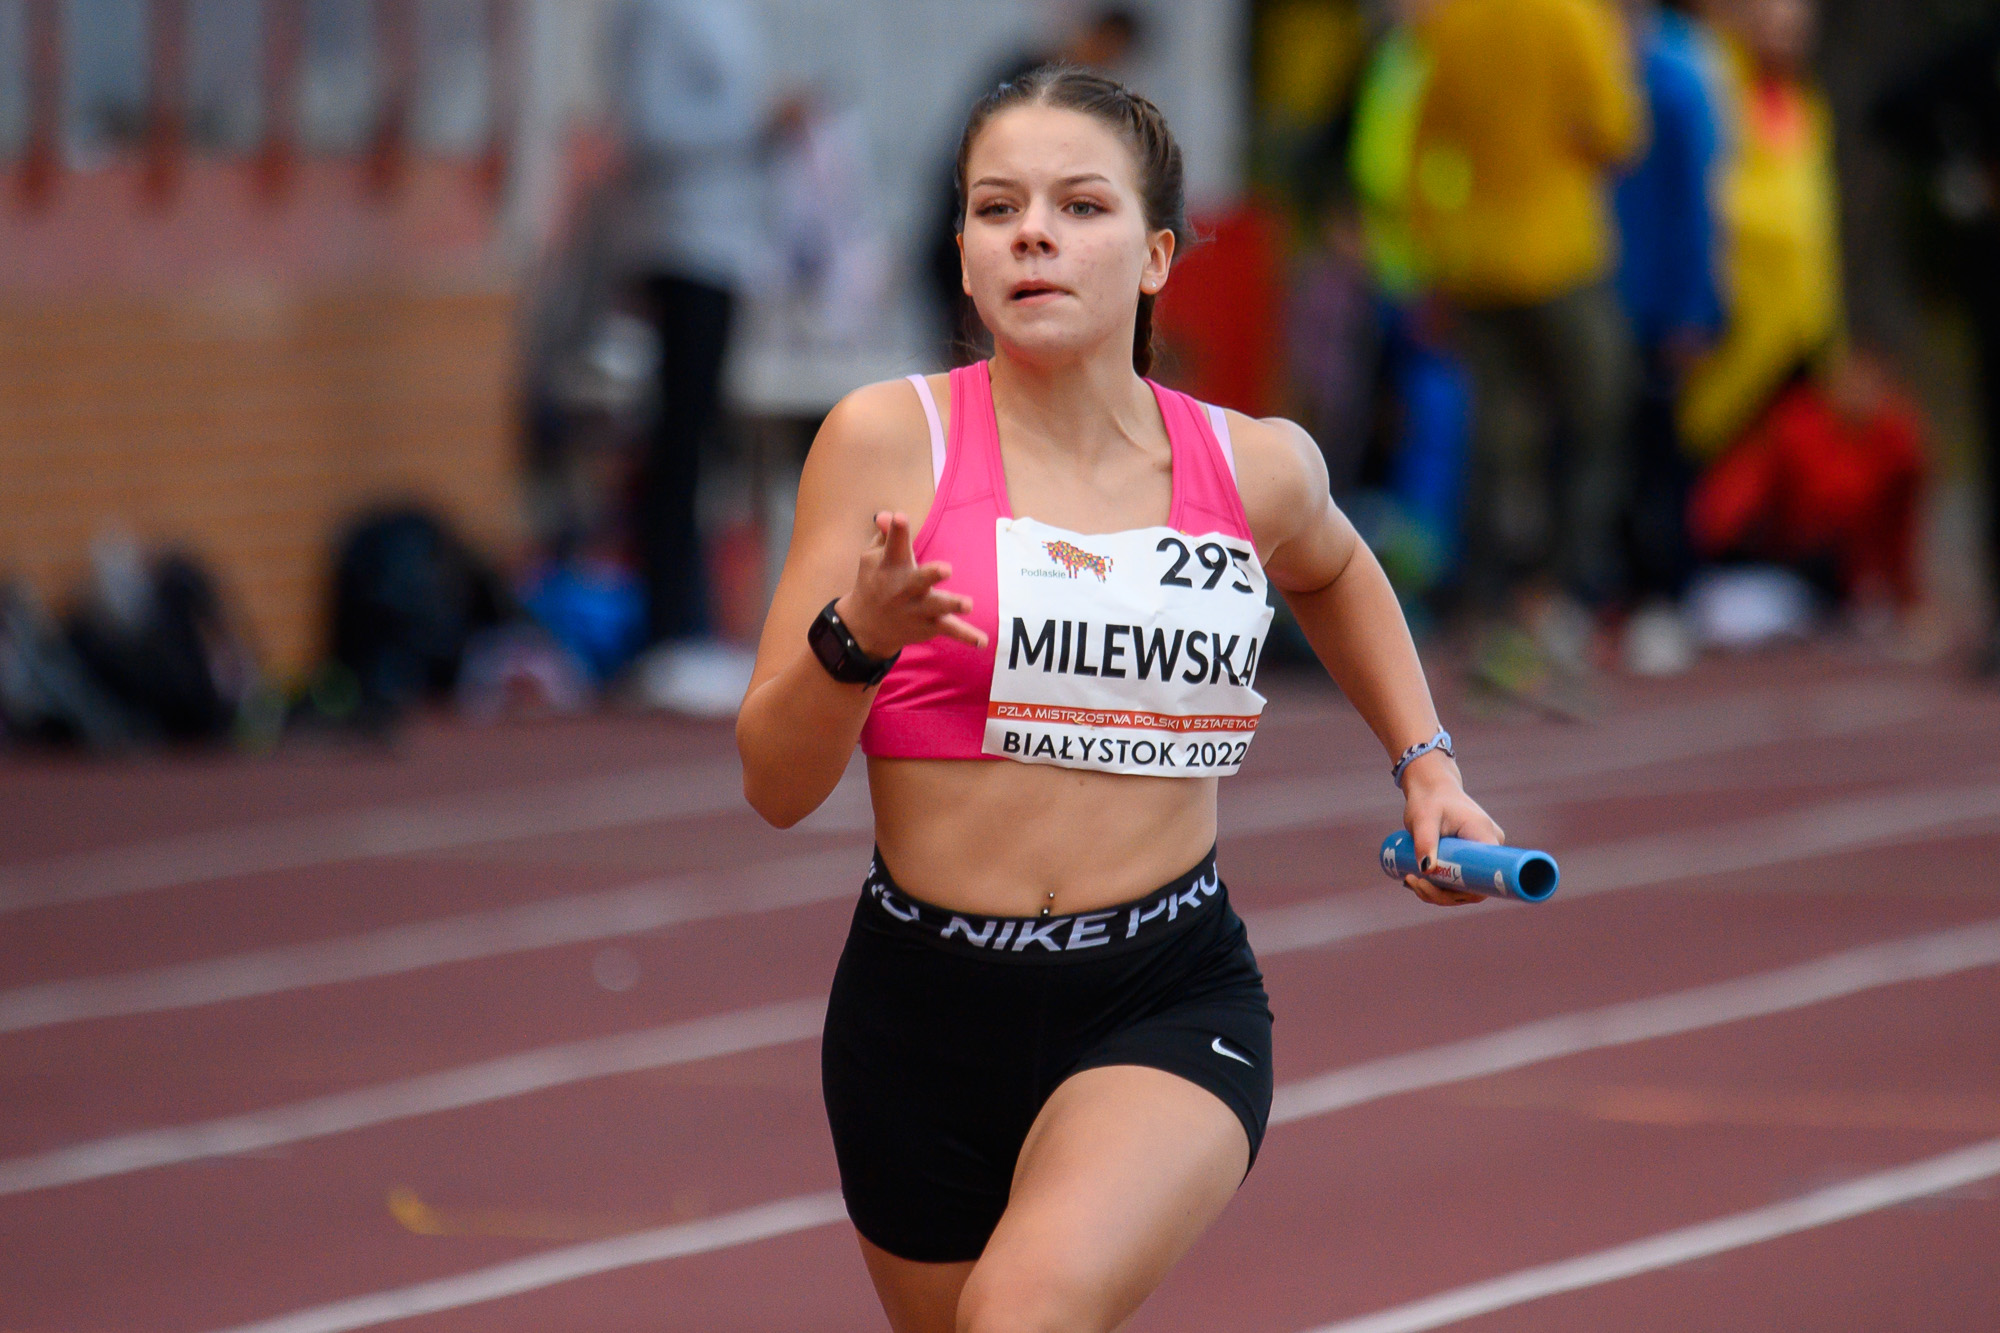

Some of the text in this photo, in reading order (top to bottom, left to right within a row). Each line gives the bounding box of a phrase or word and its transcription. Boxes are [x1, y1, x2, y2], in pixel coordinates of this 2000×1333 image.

[1021, 568, 1066, 579] Podlaskie
[1156, 537, 1255, 594] 295
[1008, 617, 1258, 687] MILEWSKA
[997, 705, 1032, 719] PZLA
[1035, 708, 1131, 725] MISTRZOSTWA
[1134, 716, 1179, 730] POLSKI
[1182, 720, 1192, 730] W
[1003, 731, 1248, 767] BIAŁYSTOK 2022
[940, 911, 1118, 951] NIKE
